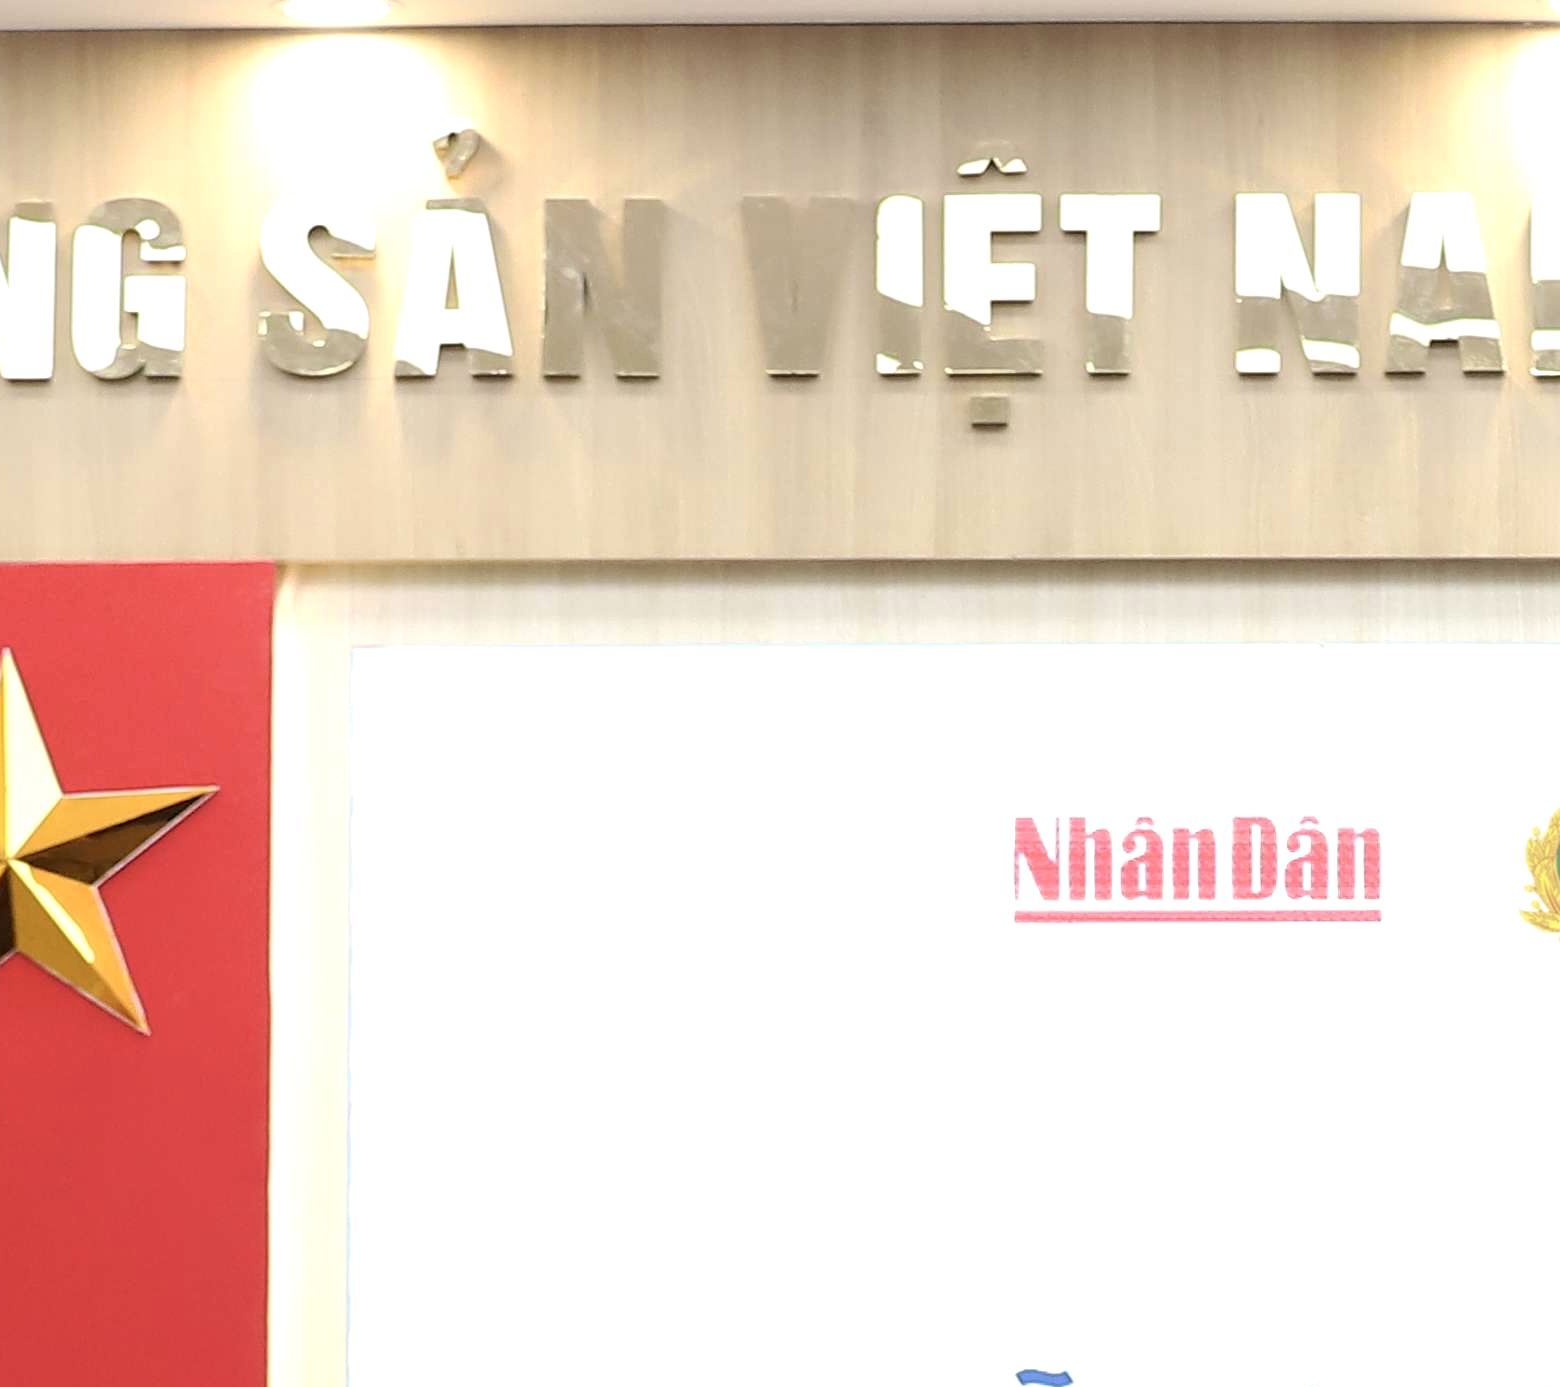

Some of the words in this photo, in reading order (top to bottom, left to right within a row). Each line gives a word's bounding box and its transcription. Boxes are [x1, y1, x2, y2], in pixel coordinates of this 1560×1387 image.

[258, 128, 663, 382] SẢN
[741, 158, 1162, 430] VIỆT
[1013, 815, 1216, 901] Nhân
[1231, 815, 1382, 901] Dân
